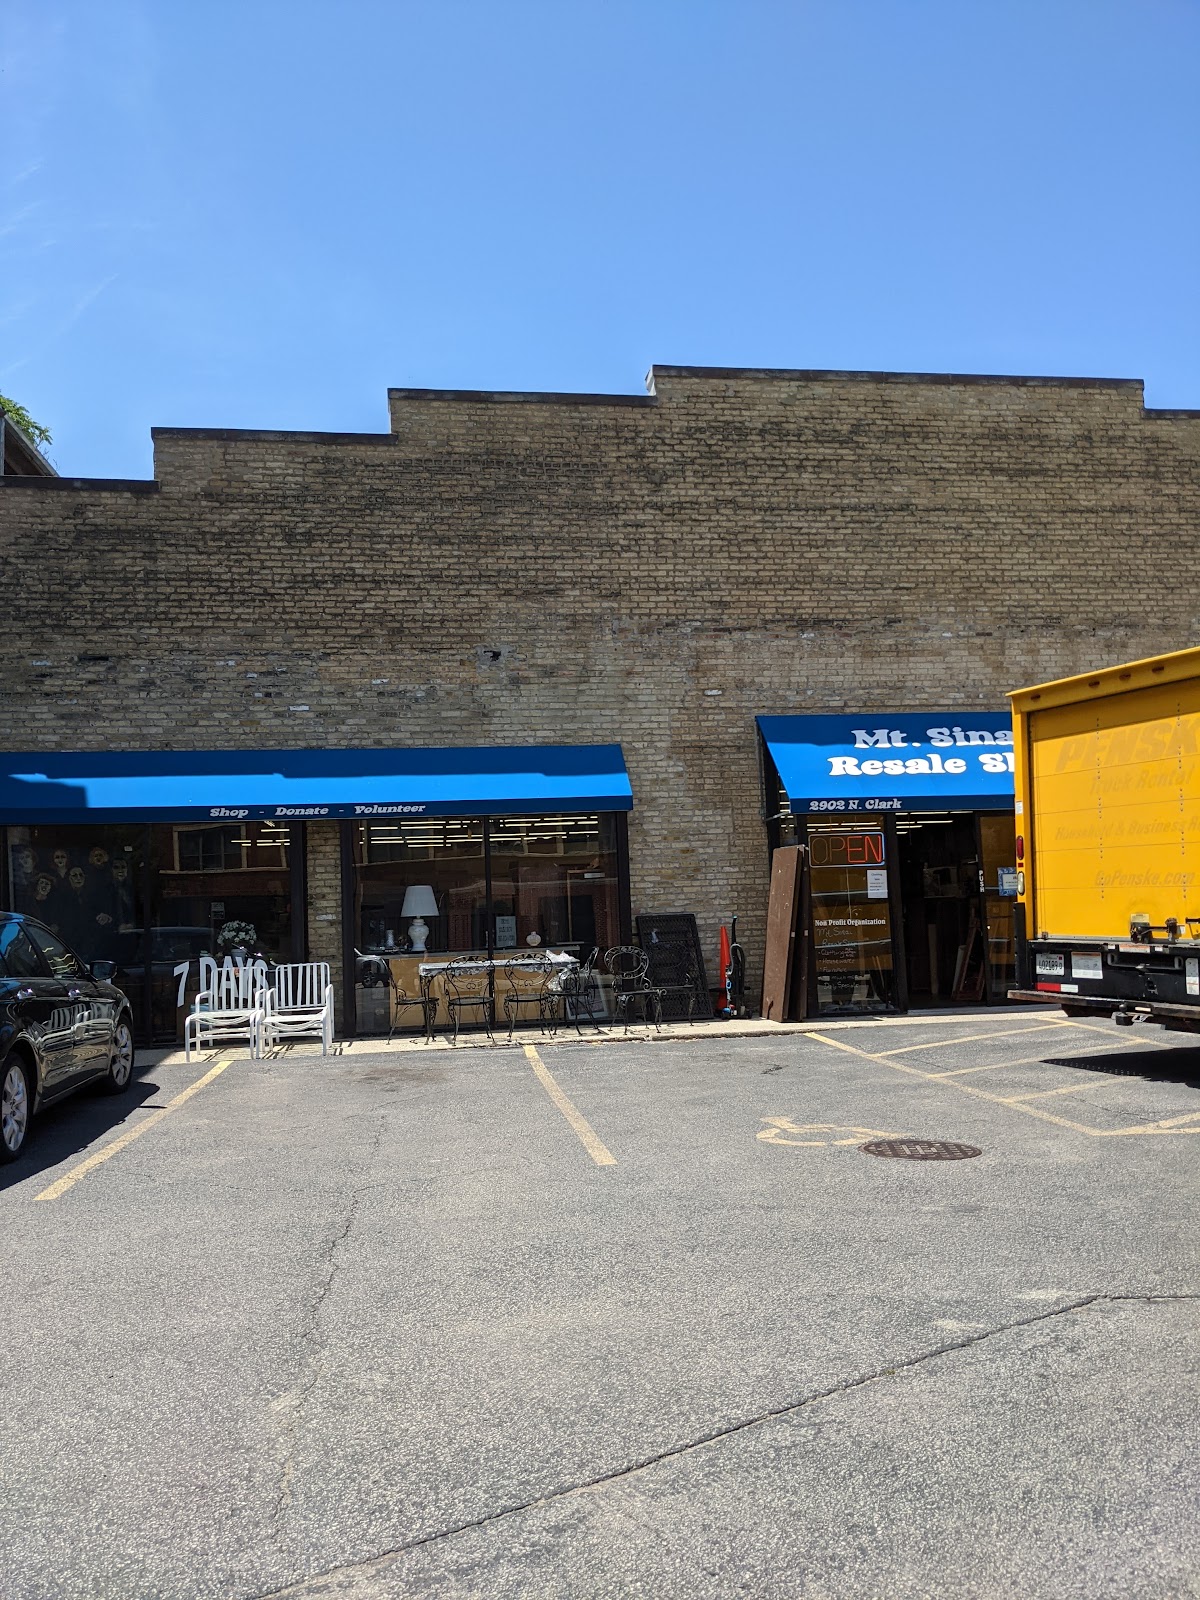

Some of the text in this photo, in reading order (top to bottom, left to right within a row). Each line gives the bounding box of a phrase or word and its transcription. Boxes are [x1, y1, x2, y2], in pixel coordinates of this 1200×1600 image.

[851, 727, 1014, 749] Mt. Sina
[1055, 717, 1200, 773] PENSK
[827, 753, 967, 776] Resale
[210, 807, 249, 818] Shop
[275, 806, 329, 816] Donate
[354, 804, 426, 814] Volunteer
[809, 798, 902, 811] 2902 N. Clark
[1127, 818, 1185, 835] Business
[811, 835, 882, 864] OPEN
[1094, 868, 1196, 887] GoPenske.com
[846, 918, 886, 926] Organization
[173, 956, 270, 1008] 7 DAYS
